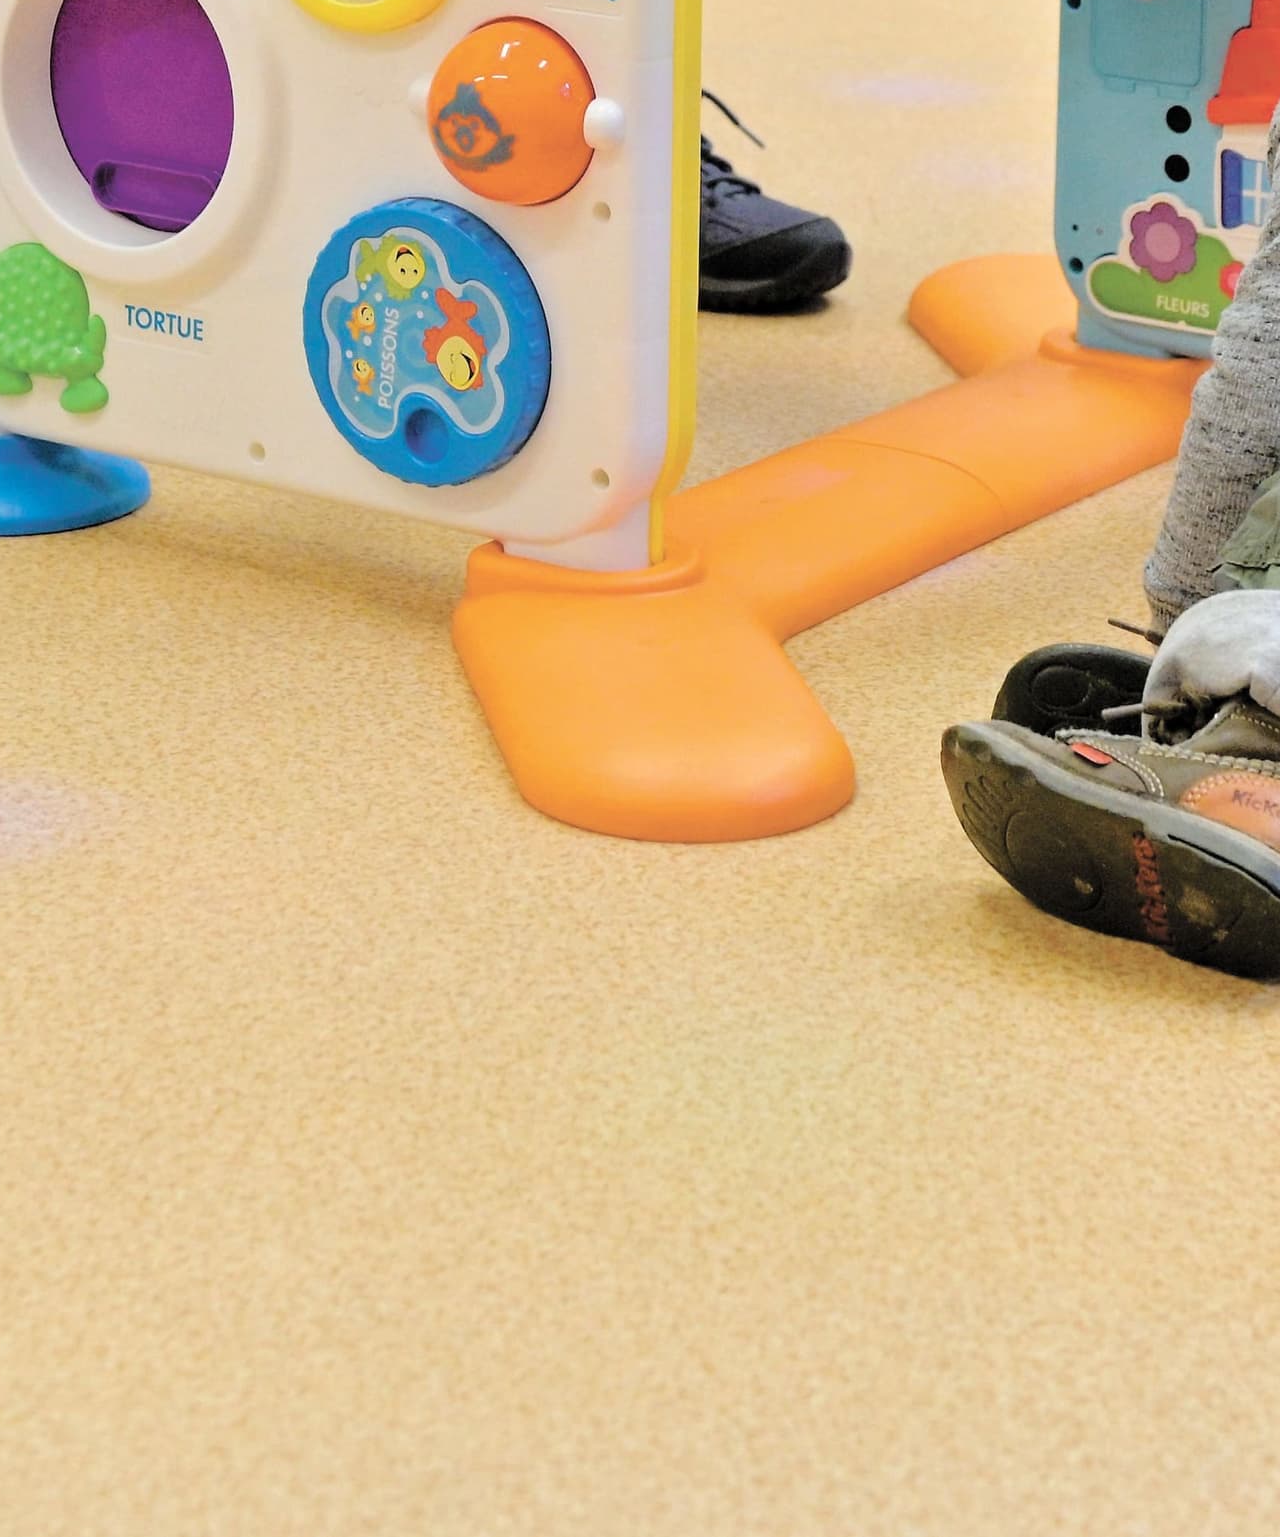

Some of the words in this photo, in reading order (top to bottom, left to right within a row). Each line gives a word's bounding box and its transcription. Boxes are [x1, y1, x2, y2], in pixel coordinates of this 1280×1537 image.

[125, 304, 203, 341] TORTUE
[1156, 294, 1210, 319] FLEURS
[377, 306, 400, 410] POISSONS
